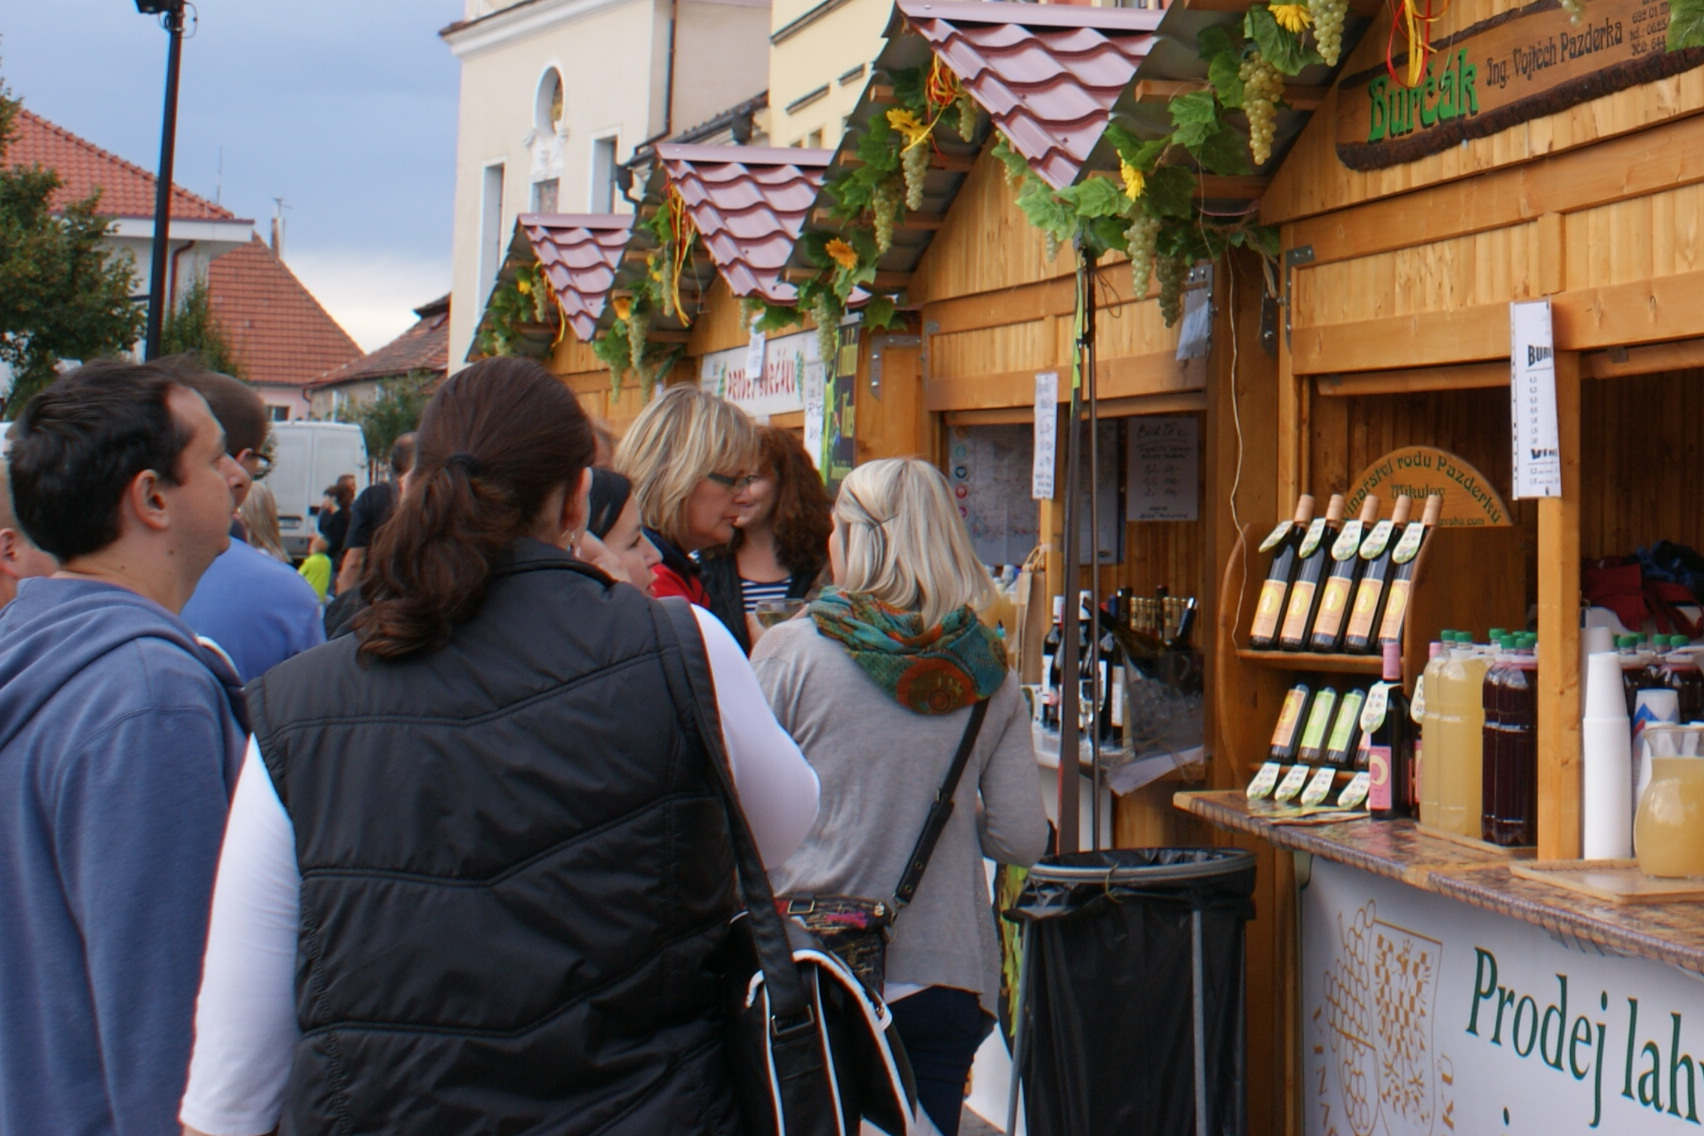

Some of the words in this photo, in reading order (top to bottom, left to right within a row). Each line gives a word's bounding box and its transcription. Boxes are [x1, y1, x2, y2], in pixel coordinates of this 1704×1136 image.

[1367, 47, 1479, 145] Burčák
[1512, 36, 1557, 81] Vojtěch
[1560, 17, 1623, 63] Pazderka
[1396, 450, 1432, 470] rodu
[1465, 945, 1608, 1129] Prodej
